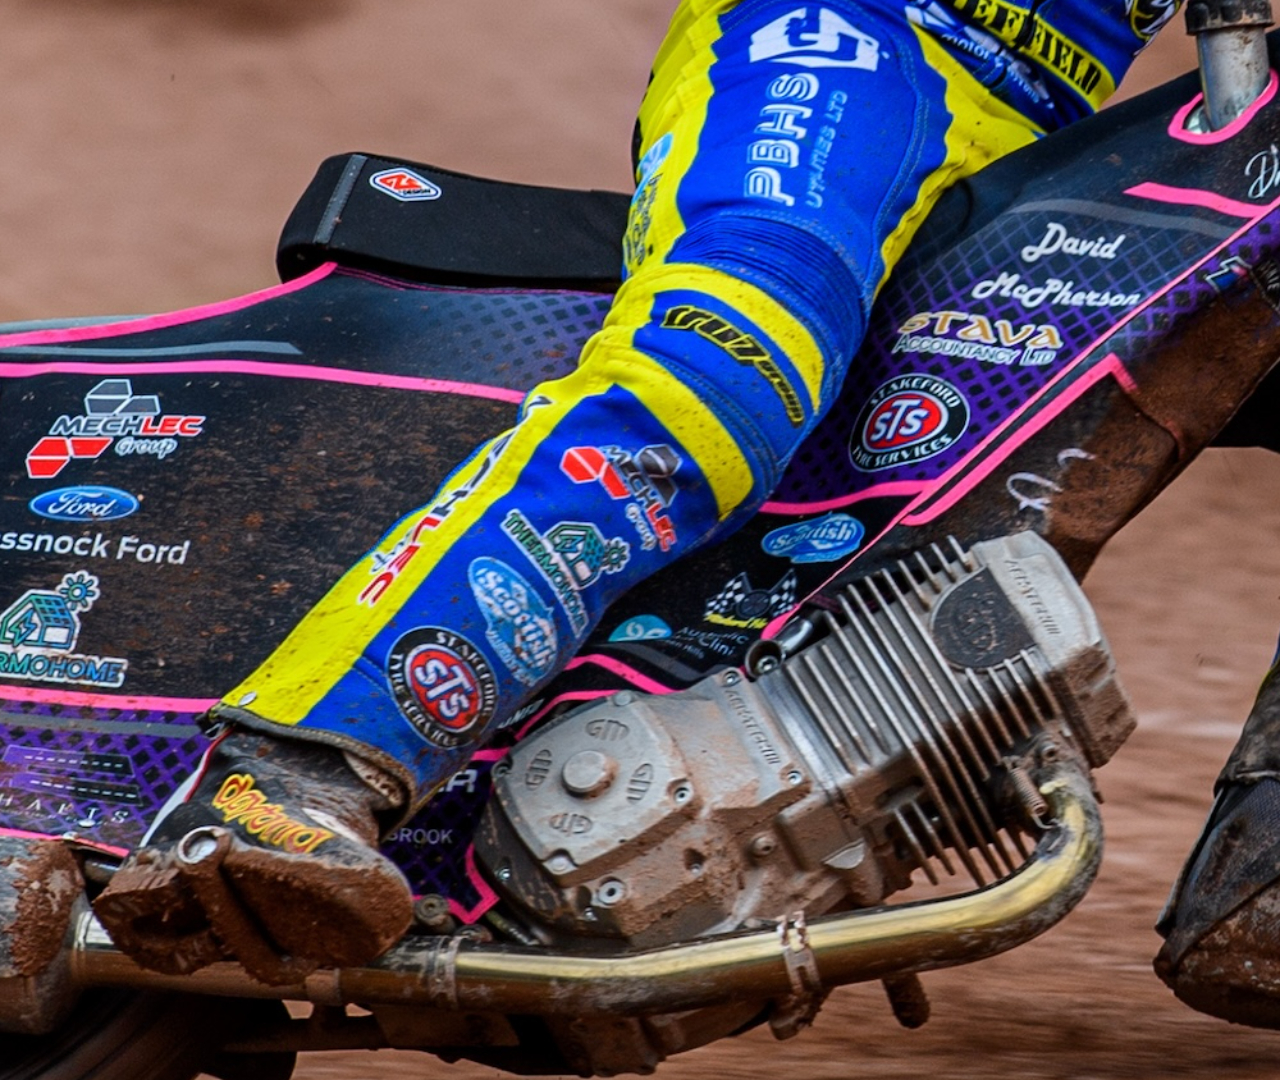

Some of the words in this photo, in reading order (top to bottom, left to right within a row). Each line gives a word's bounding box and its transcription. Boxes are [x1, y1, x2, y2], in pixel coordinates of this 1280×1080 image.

[824, 89, 849, 124] LTD
[743, 72, 820, 208] PBHS
[1021, 222, 1126, 264] David
[971, 271, 1141, 310] McPherson
[870, 376, 961, 408] STAKEFORD
[49, 415, 206, 438] MECHLEC
[870, 398, 931, 443] STS
[114, 436, 180, 460] Group
[873, 432, 953, 468] SERVICES
[45, 492, 113, 518] Ford
[600, 445, 678, 552] MECHLEC
[117, 537, 191, 566] Ford
[770, 521, 853, 551] Scottish
[476, 568, 558, 672] Scottish
[414, 658, 474, 718] STS
[211, 773, 336, 855] daytona
